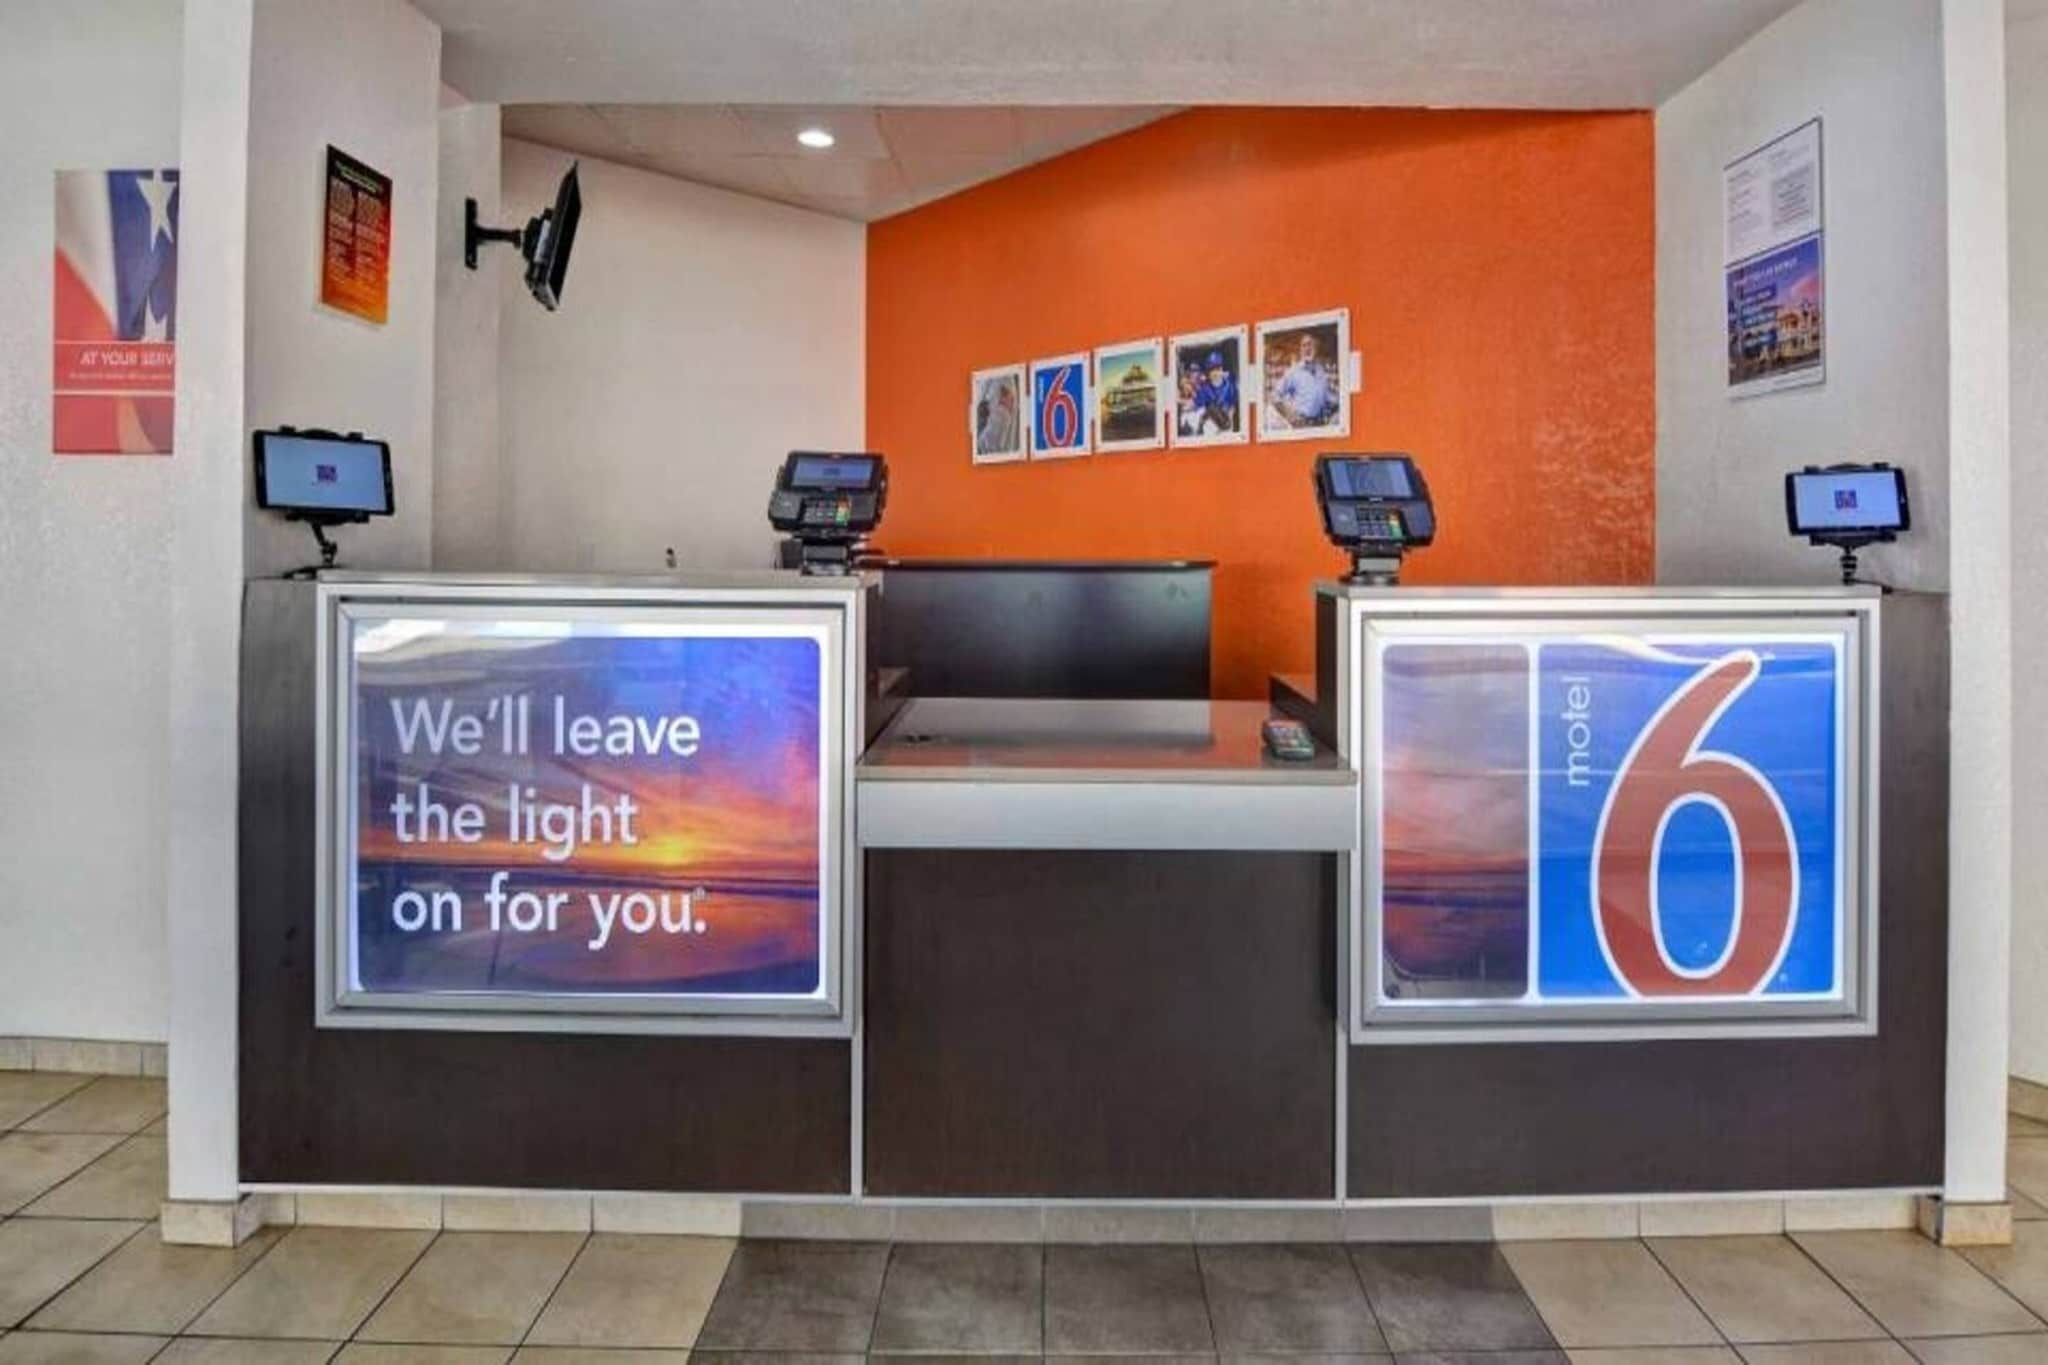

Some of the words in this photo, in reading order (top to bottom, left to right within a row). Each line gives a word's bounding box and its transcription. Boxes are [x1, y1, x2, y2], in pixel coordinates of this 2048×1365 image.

[80, 350, 98, 365] AT
[101, 351, 138, 366] YOUR
[1043, 366, 1078, 448] 6
[391, 694, 529, 755] We'll
[554, 694, 700, 756] leave
[391, 783, 487, 843] the
[508, 783, 639, 861] light
[1561, 675, 1591, 787] motel
[1590, 650, 1800, 999] 6
[391, 890, 462, 931] on
[484, 871, 568, 932] for
